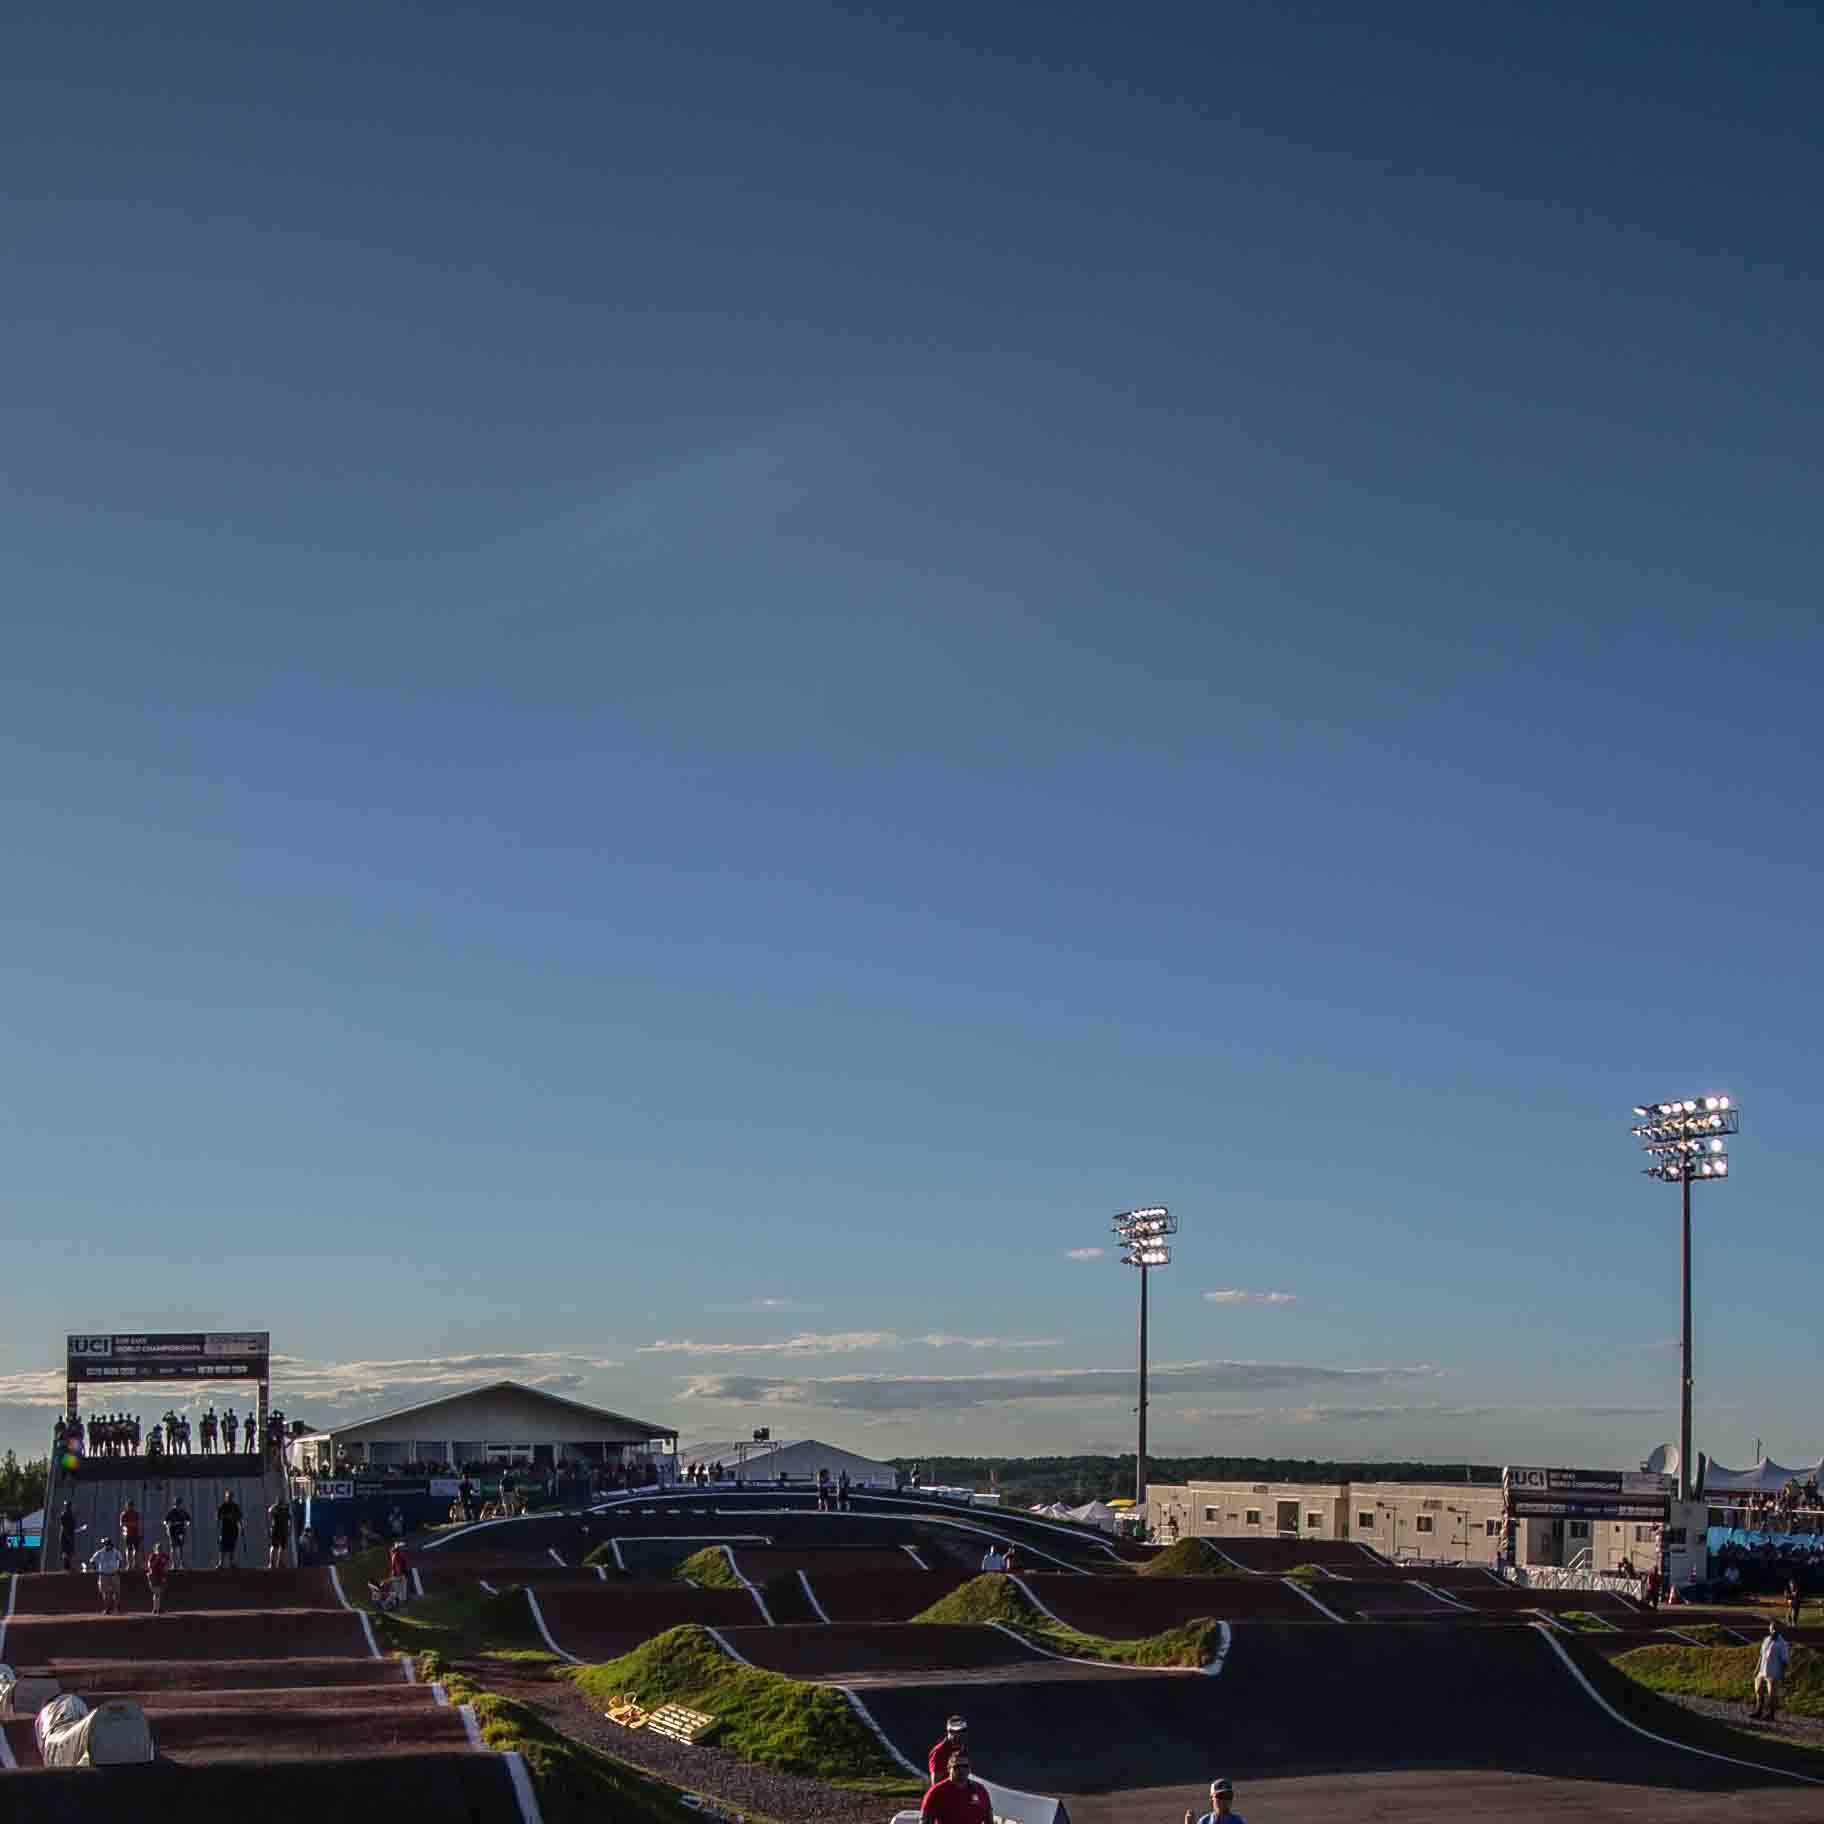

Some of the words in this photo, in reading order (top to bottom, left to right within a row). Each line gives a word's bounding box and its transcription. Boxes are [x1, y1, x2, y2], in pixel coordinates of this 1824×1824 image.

[75, 1338, 108, 1352] UCI
[1516, 1471, 1545, 1486] UCI
[323, 1483, 351, 1495] UCI
